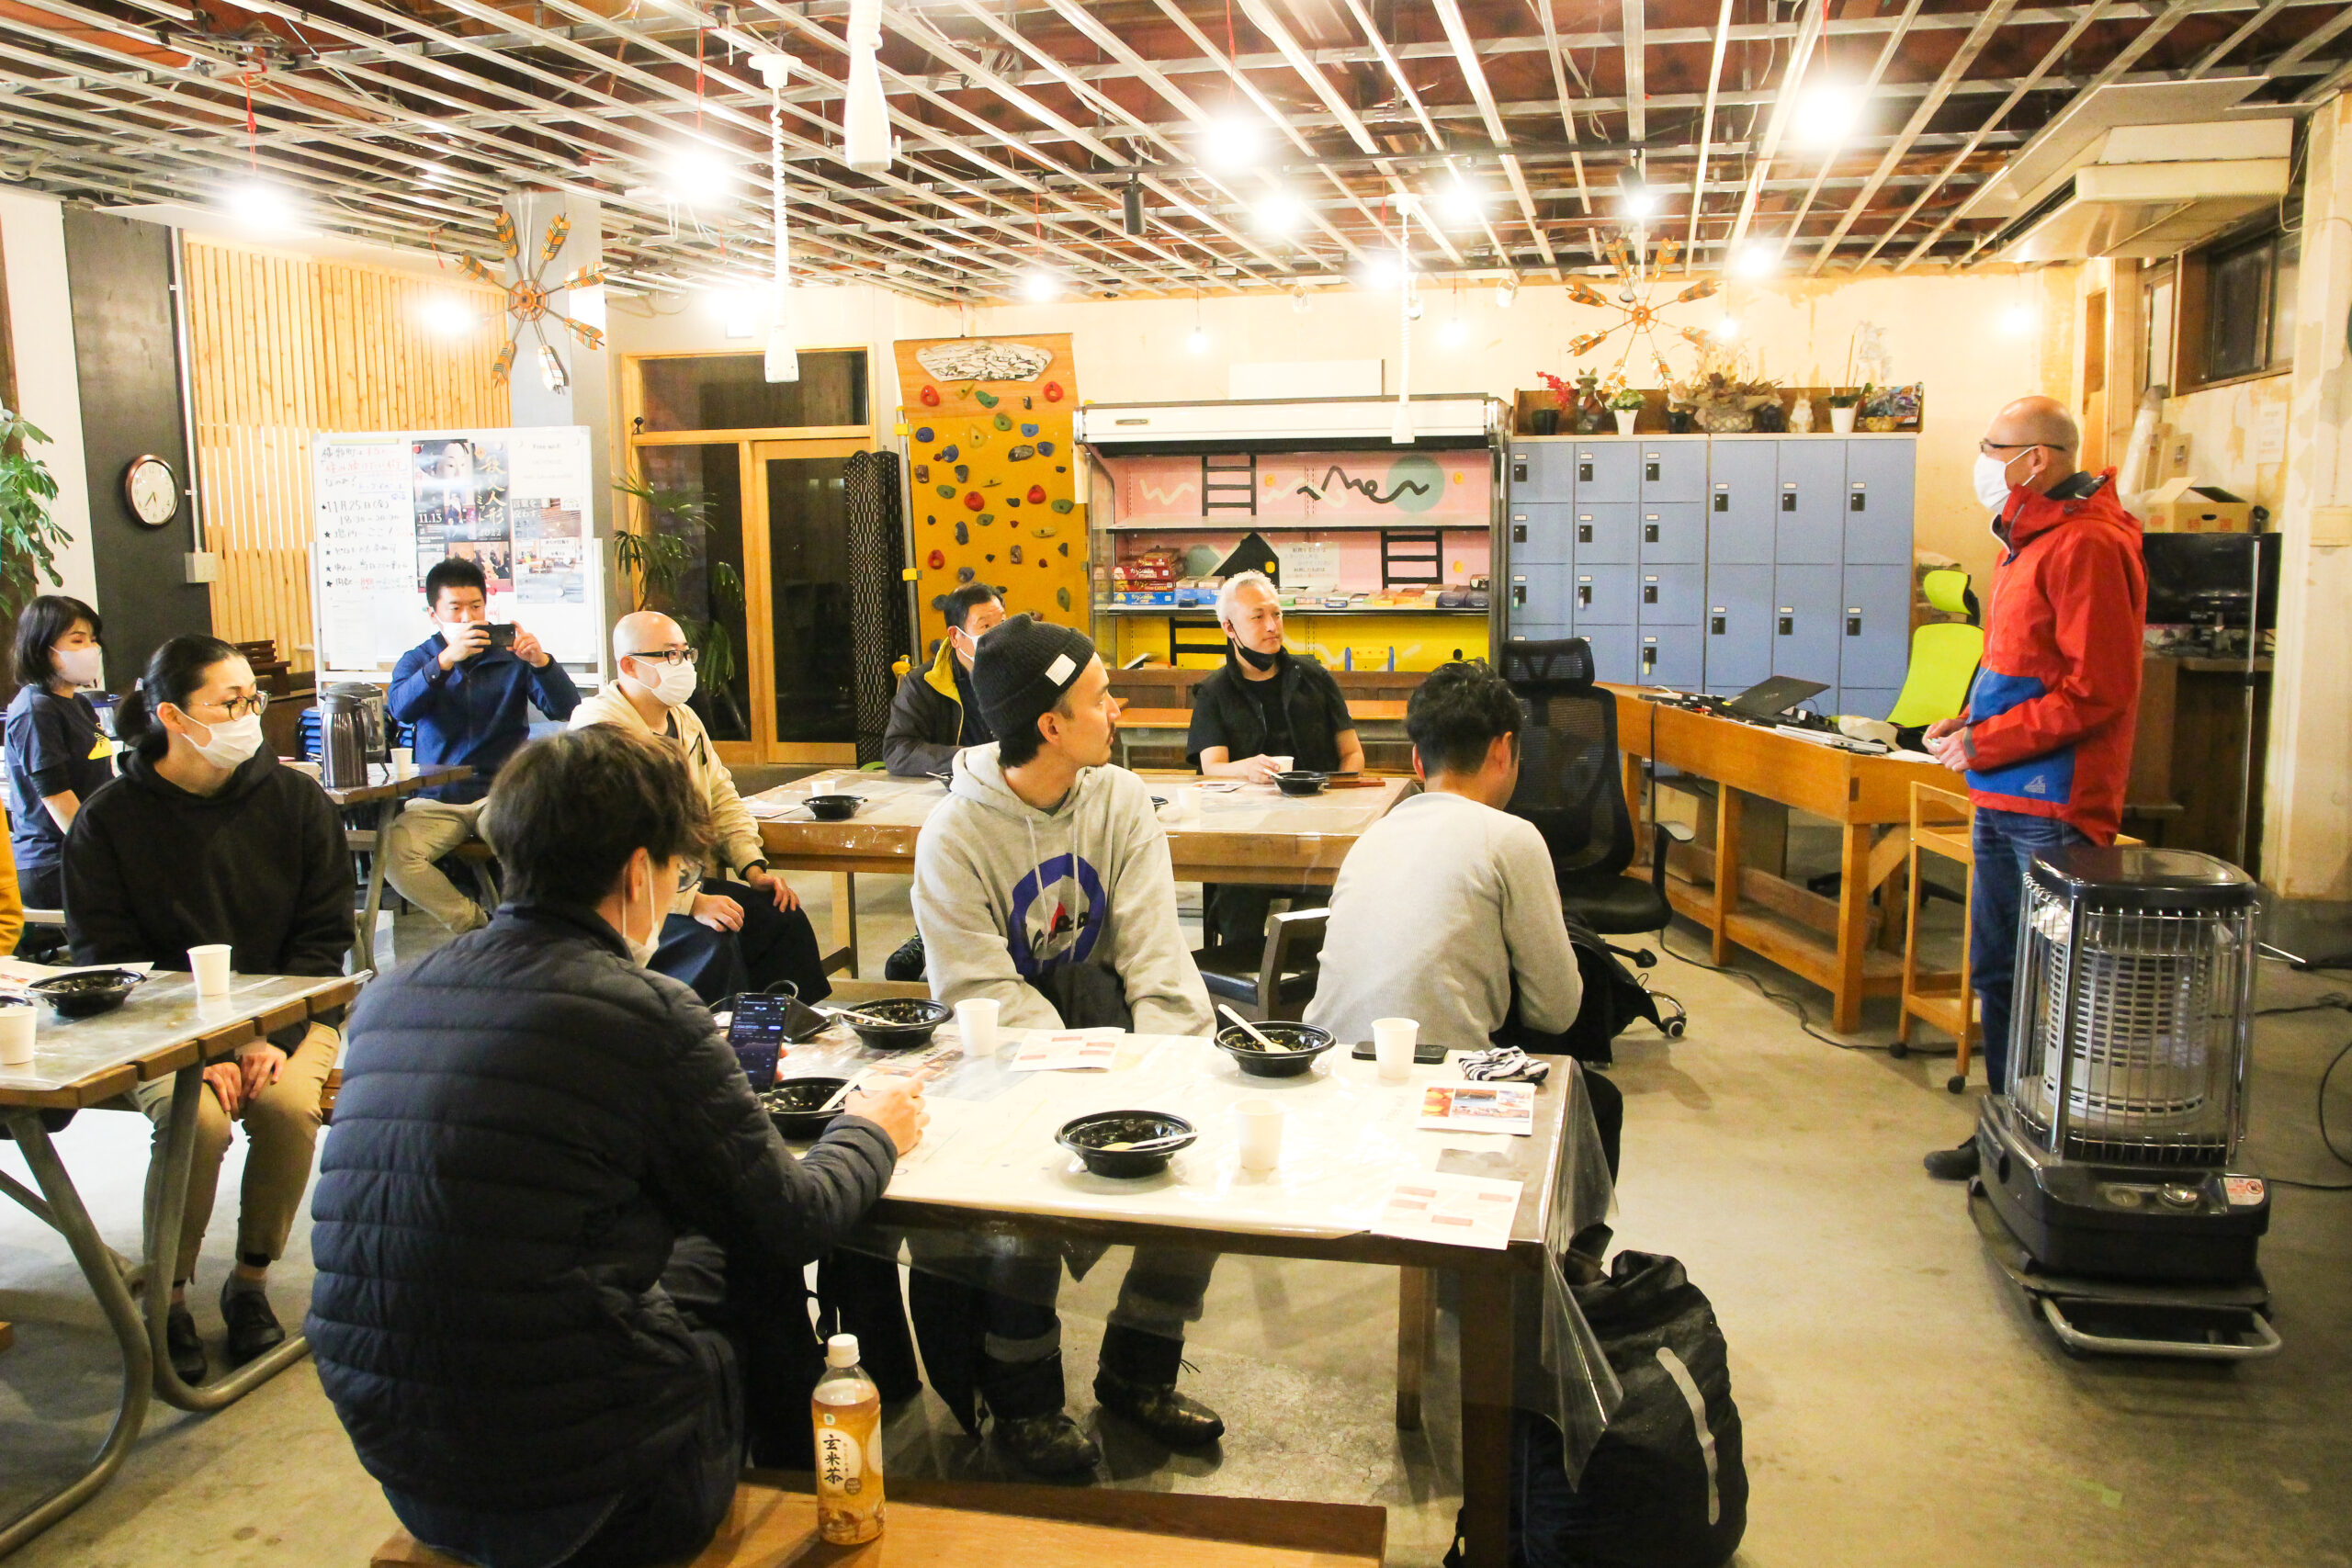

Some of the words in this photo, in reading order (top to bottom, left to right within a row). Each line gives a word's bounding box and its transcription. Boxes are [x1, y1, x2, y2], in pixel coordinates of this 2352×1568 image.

[418, 513, 443, 524] 11.13
[823, 1434, 843, 1484] 玄米茶
